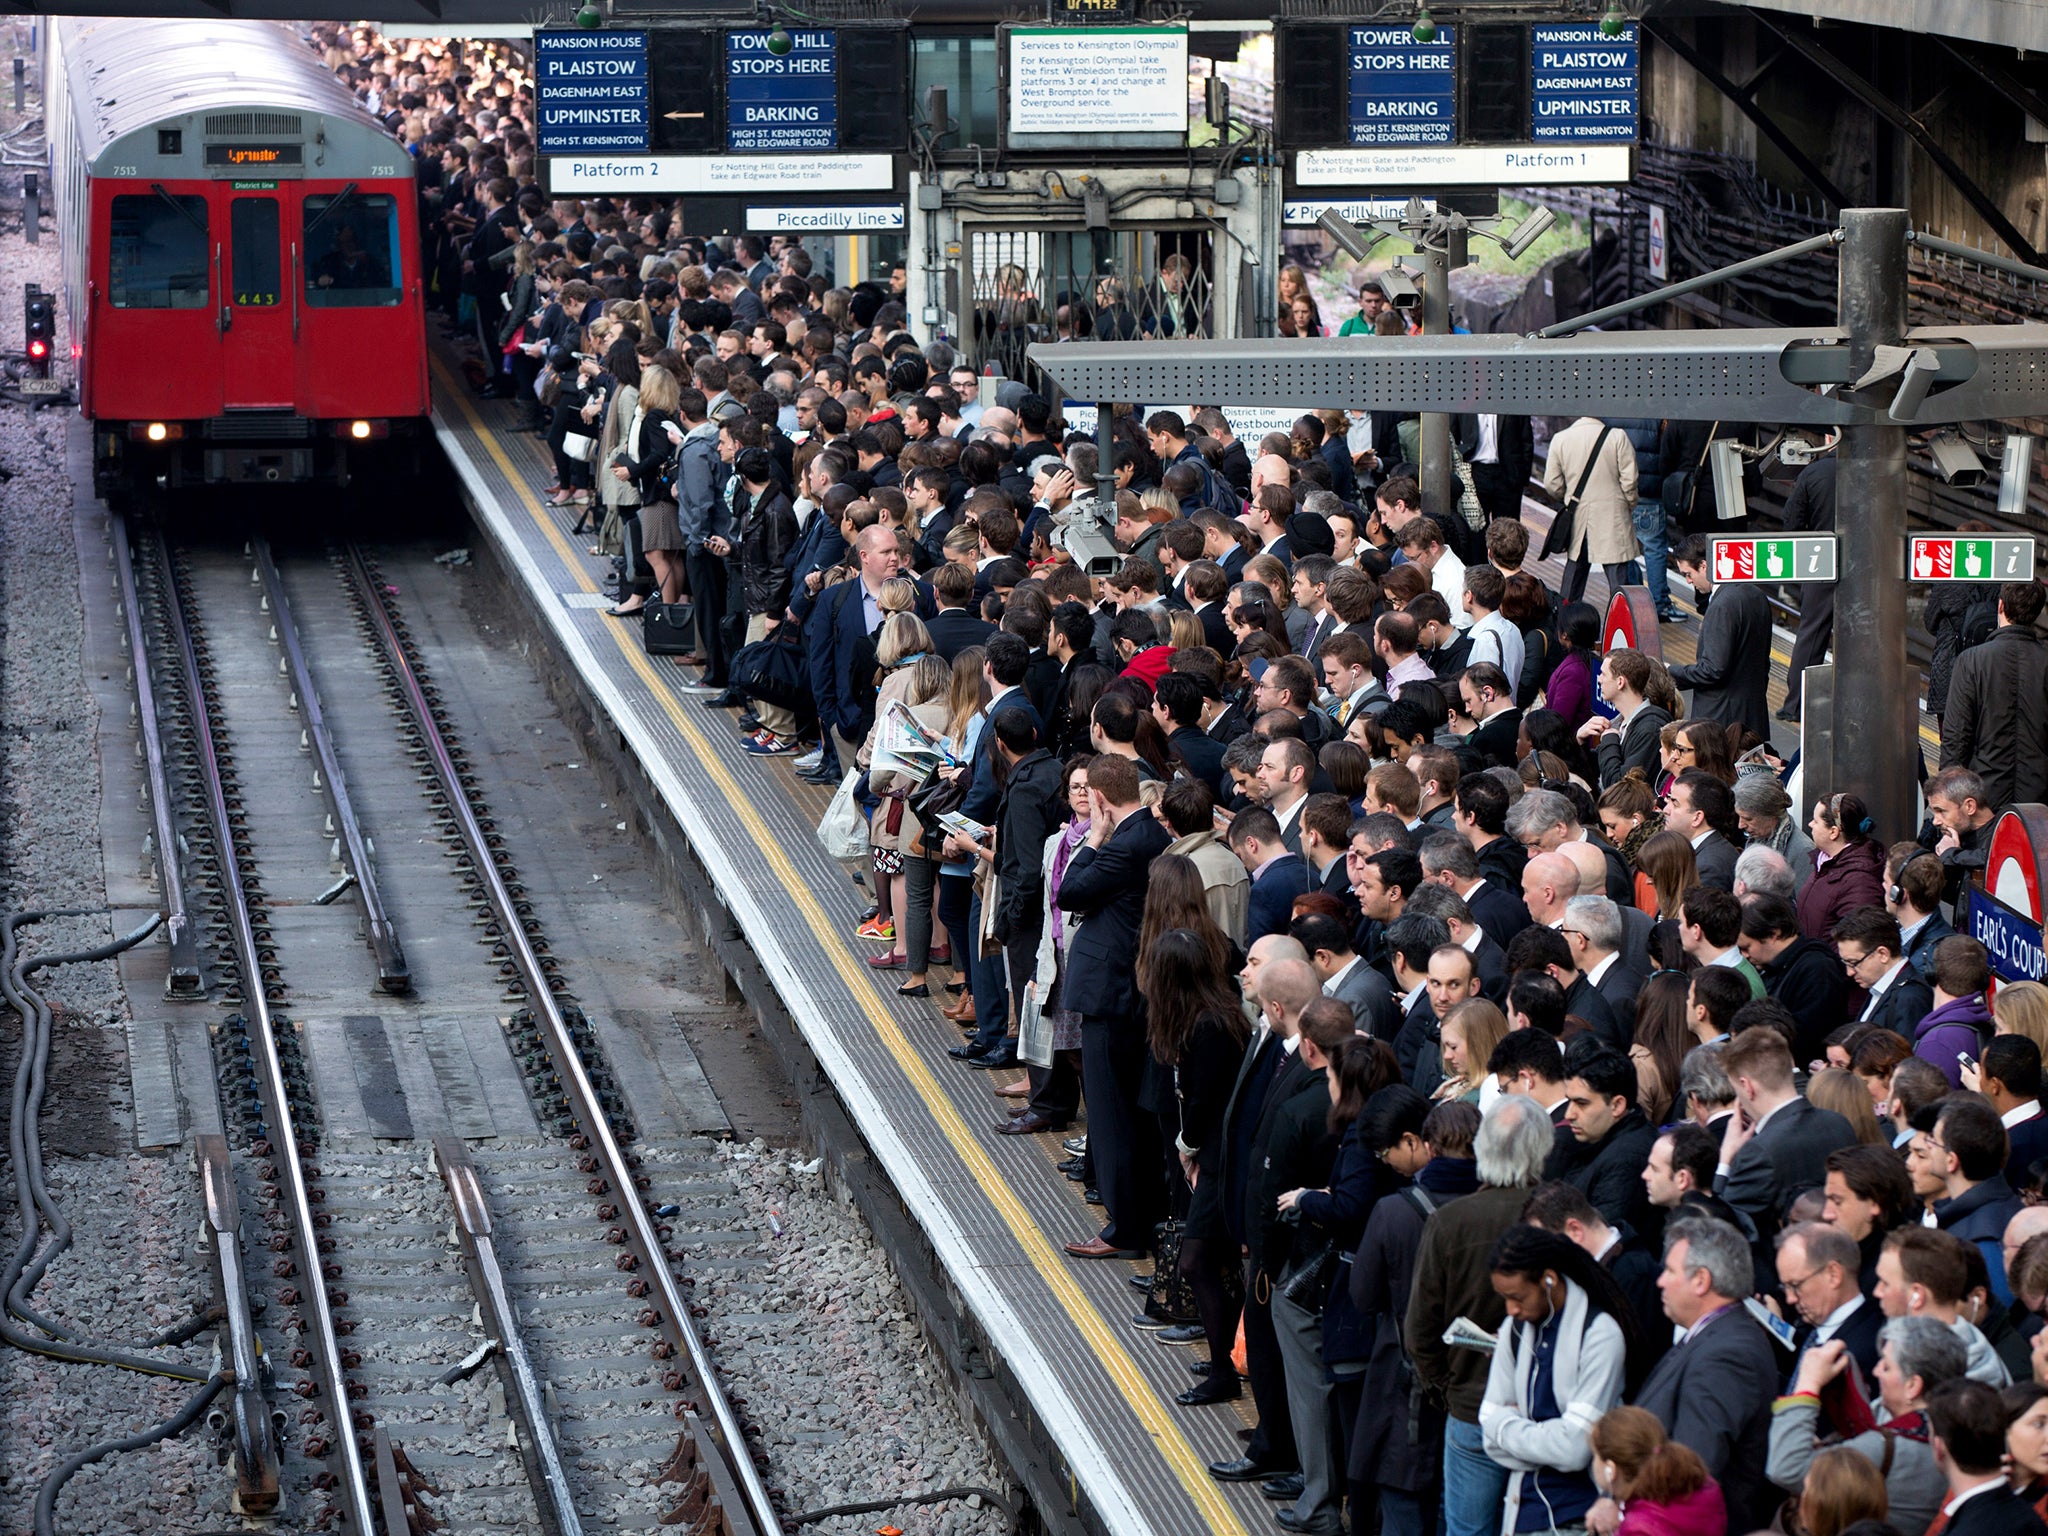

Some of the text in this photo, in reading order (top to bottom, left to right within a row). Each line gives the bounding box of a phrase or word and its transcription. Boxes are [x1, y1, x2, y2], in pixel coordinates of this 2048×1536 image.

[795, 34, 829, 48] HILL
[1354, 32, 1412, 45] TOWER
[1536, 30, 1633, 42] MANSION HOUSE
[542, 38, 641, 48] MANSION HOUSE
[1021, 42, 1060, 50] Services
[1078, 41, 1130, 51] Kensington
[1134, 40, 1178, 49] (Olympia)
[1039, 57, 1089, 66] Kensington
[1093, 56, 1136, 65] (Olympia)
[1354, 55, 1449, 70] STOPS HERE
[1543, 53, 1627, 68] PLAISTOW
[550, 61, 636, 75] PLAISTOW
[732, 59, 830, 74] STOPS HERE
[1021, 67, 1036, 75] the
[1142, 66, 1167, 74] (from
[1021, 78, 1066, 86] platforms
[1122, 78, 1152, 86] change
[1537, 78, 1632, 89] DAGENHAM EAST
[543, 86, 642, 98] DAGENHAM EAST
[1049, 88, 1093, 97] Brompton
[1021, 98, 1112, 108] Overground service.
[1539, 100, 1631, 115] UPMINSTER
[746, 107, 818, 121] BARKING
[1367, 102, 1438, 116] BARKING
[546, 109, 641, 124] UPMINSTER
[732, 129, 831, 138] HIGH ST. KENSINGTON
[1353, 124, 1449, 133] HIGH ST. KENSINGTON
[1536, 126, 1633, 136] HIGH ST. KENSINGTON
[543, 135, 643, 145] HIGH ST. KENSINGTON
[735, 138, 829, 148] AND EDGWARE ROAD
[1356, 133, 1448, 142] AND EDGWARE ROAD
[1412, 156, 1455, 164] Paddington
[1506, 153, 1586, 167] Platform 1
[113, 166, 137, 176] 7513
[371, 166, 394, 176] 7513
[574, 163, 658, 177] Platform 2
[818, 162, 862, 170] Paddington
[1340, 166, 1372, 174] Edgware
[1301, 206, 1406, 221] Picadilly line
[777, 212, 886, 229] Piccadilly line
[23, 381, 37, 391] EC
[1977, 910, 2007, 959] EARL'S
